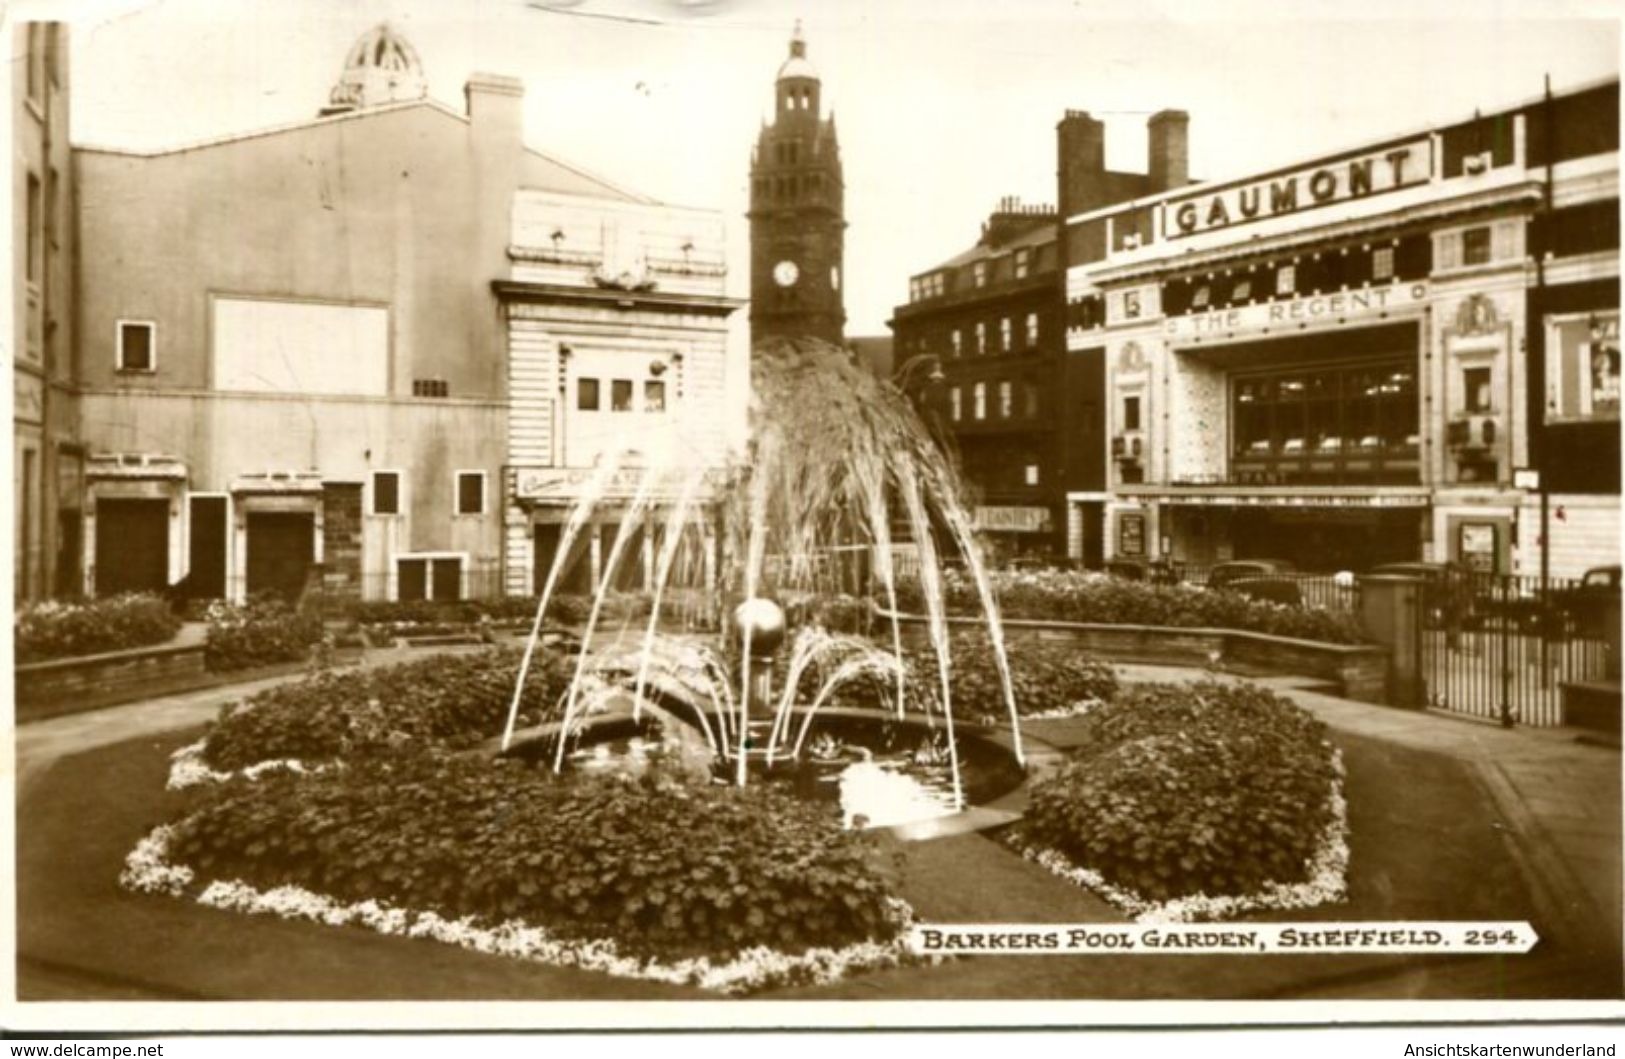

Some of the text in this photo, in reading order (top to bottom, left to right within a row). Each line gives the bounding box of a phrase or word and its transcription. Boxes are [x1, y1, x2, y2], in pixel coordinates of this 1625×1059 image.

[1175, 148, 1411, 232] GAUMONT
[1190, 288, 1392, 333] THE REGENT
